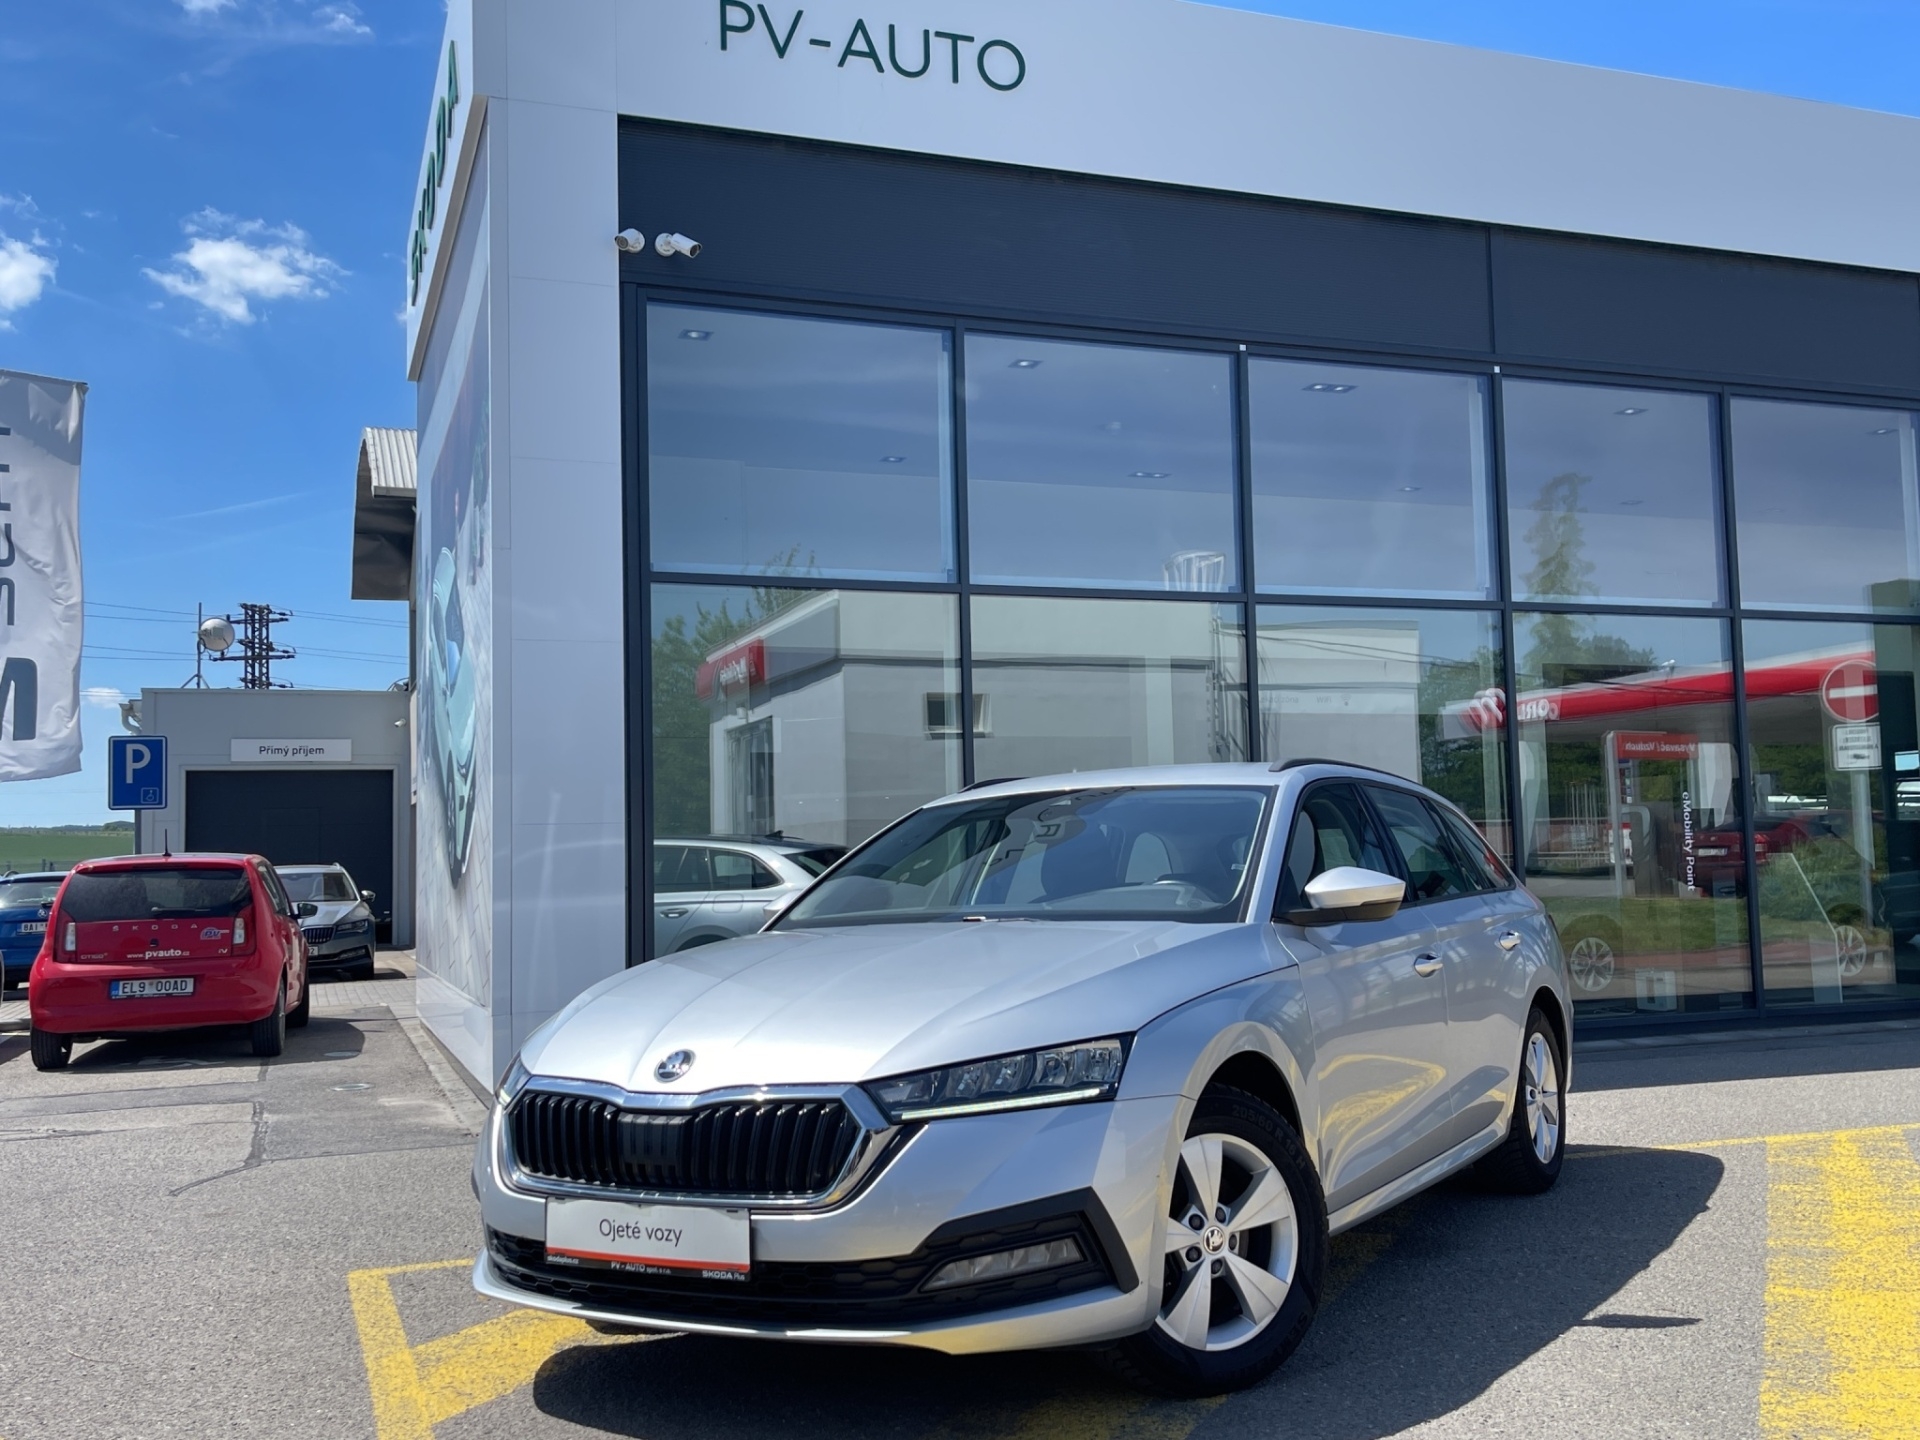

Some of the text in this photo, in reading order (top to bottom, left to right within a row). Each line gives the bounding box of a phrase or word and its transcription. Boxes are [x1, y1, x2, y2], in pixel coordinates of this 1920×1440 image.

[719, 0, 1027, 91] PV-AUTO
[125, 743, 151, 784] P
[259, 745, 325, 757] Přímý příjem
[1682, 791, 1696, 891] eMobility Point
[122, 982, 146, 994] EL9
[599, 1218, 683, 1247] Ojeté vozy
[625, 1263, 645, 1272] AUTO
